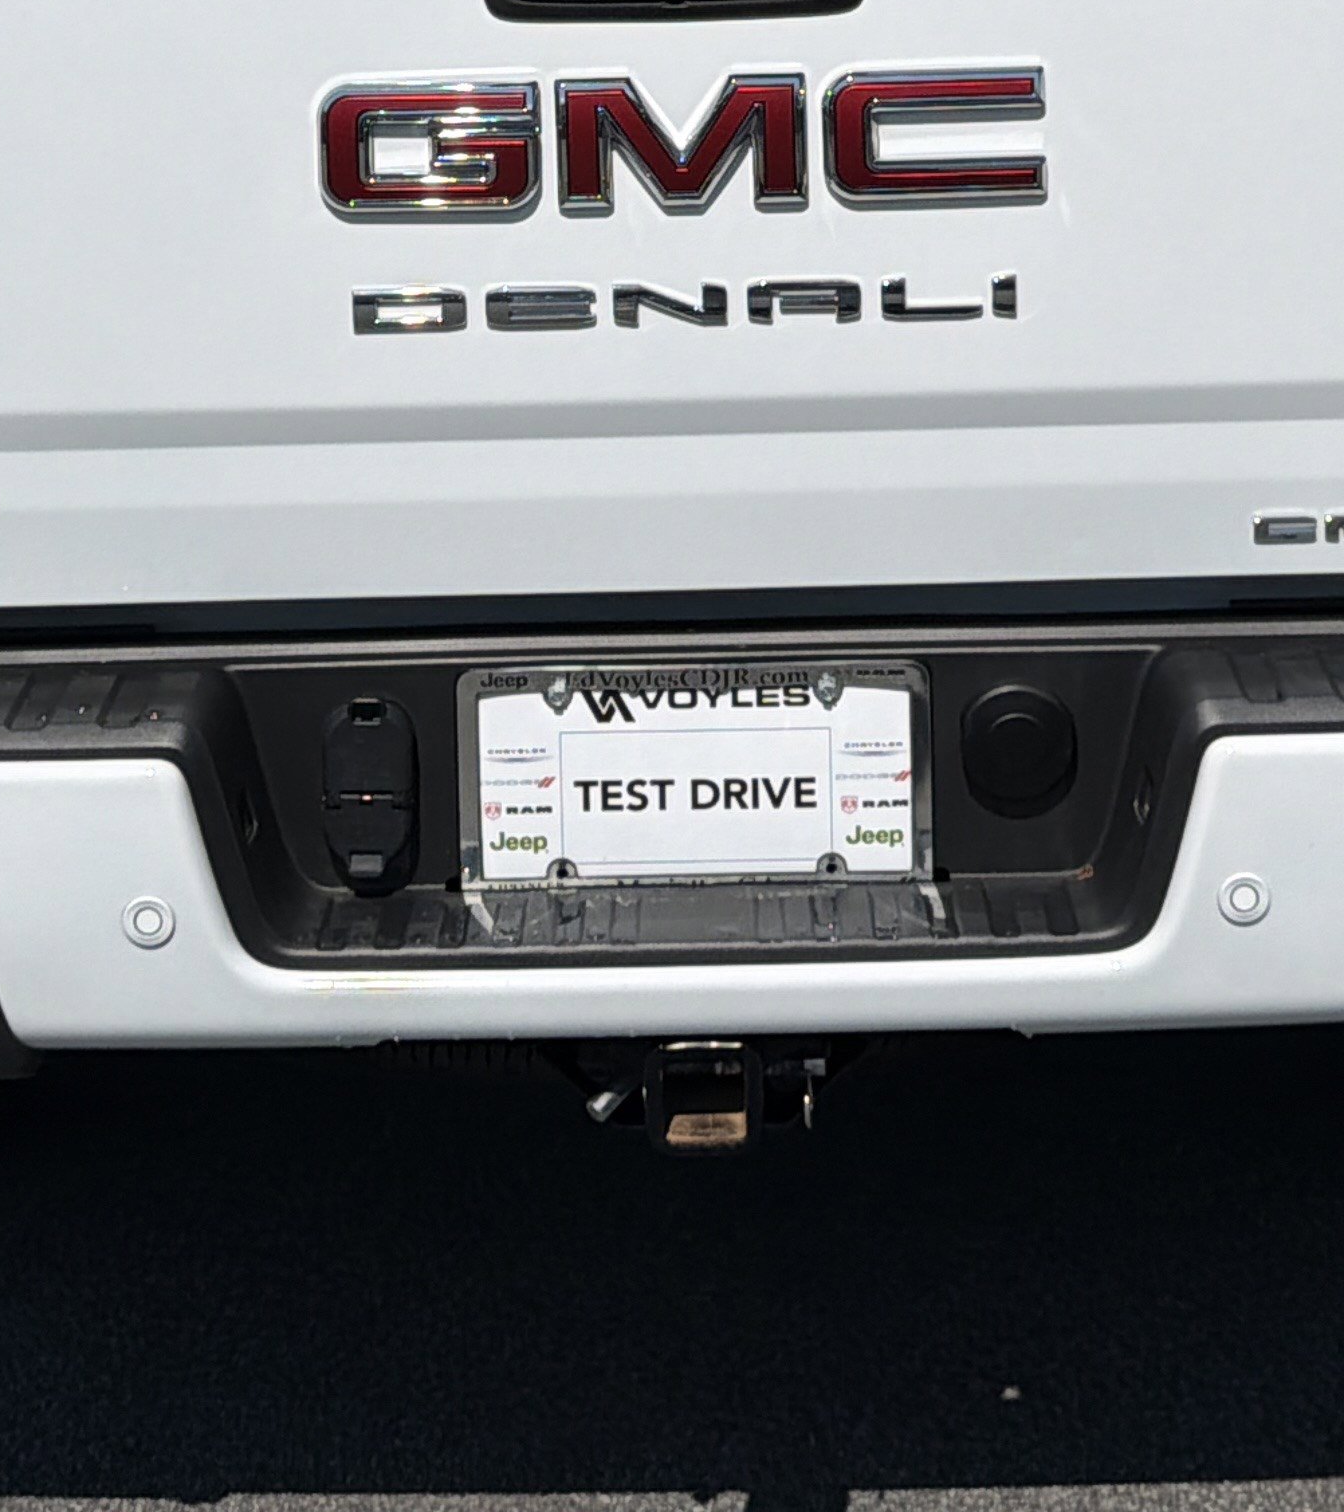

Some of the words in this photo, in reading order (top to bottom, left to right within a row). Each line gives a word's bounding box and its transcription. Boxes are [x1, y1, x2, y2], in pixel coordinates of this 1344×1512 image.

[320, 66, 1047, 218] GMC
[352, 275, 1018, 334] DENALI
[480, 672, 529, 688] Jeep
[639, 685, 811, 709] VOYLES
[574, 779, 674, 812] TEST
[691, 776, 818, 810] DRIVE
[862, 799, 908, 808] RAM
[506, 806, 552, 815] RAM
[490, 831, 548, 854] Jeep
[846, 824, 904, 847] Jeep
